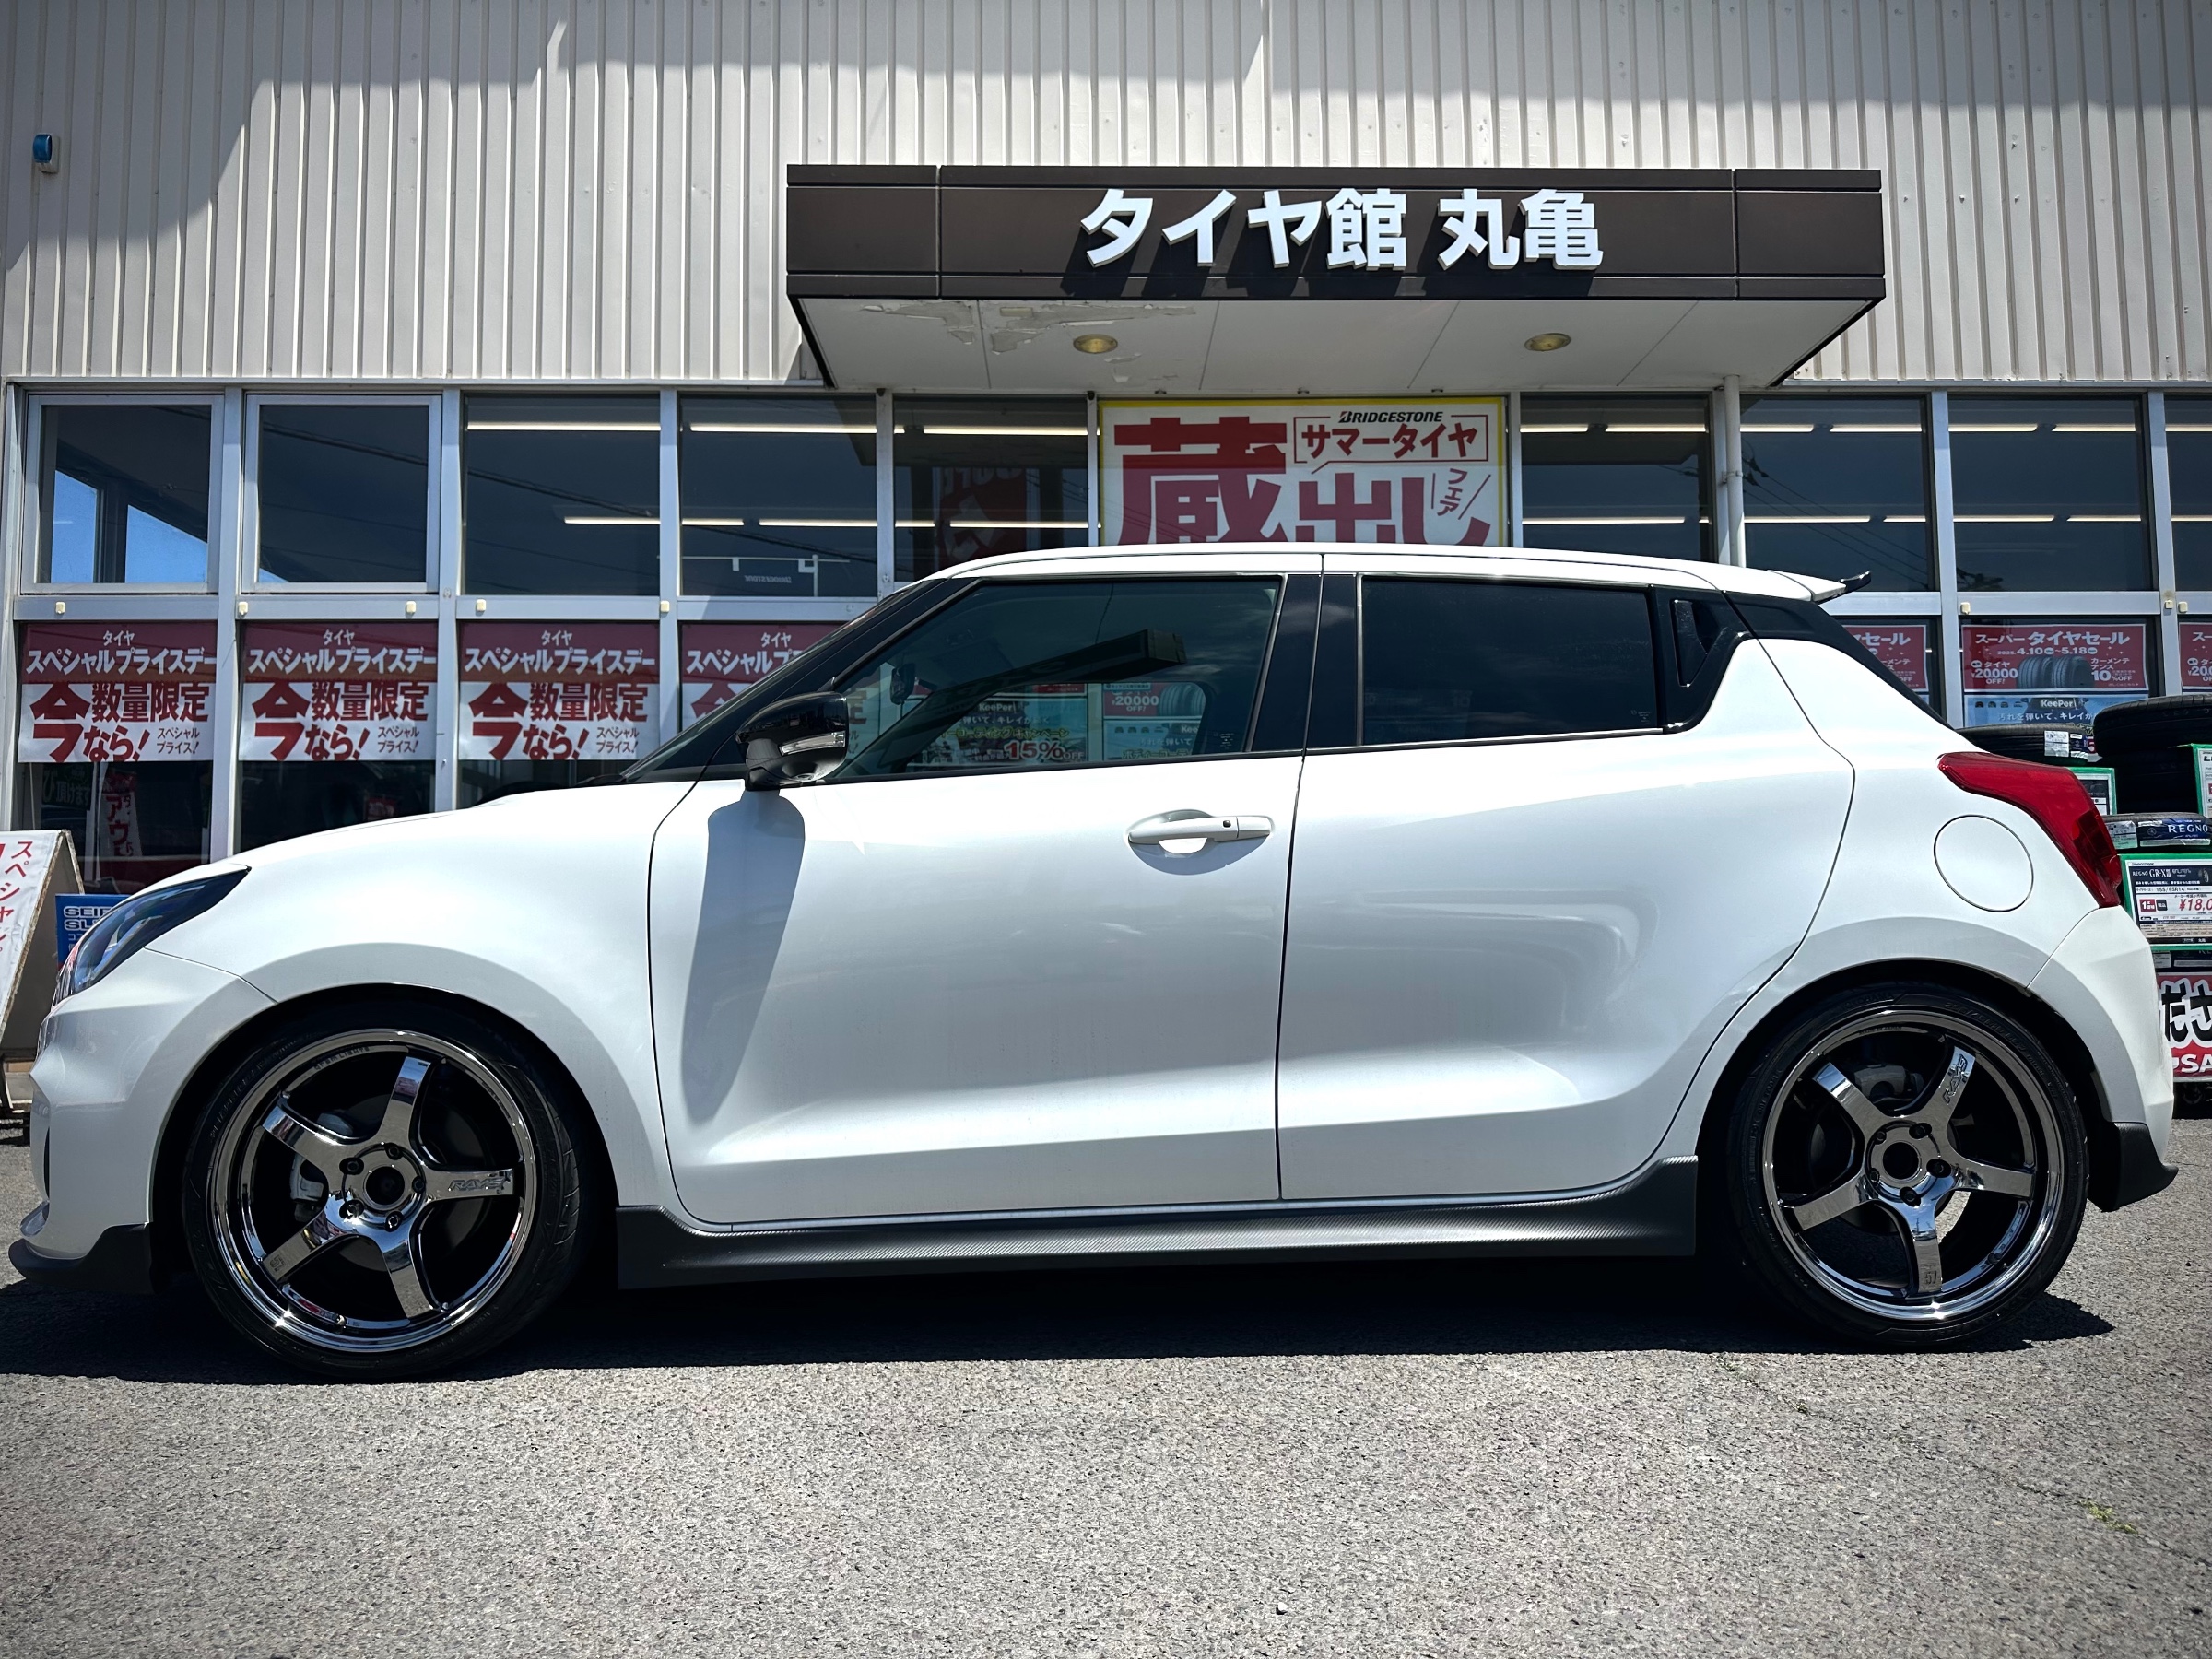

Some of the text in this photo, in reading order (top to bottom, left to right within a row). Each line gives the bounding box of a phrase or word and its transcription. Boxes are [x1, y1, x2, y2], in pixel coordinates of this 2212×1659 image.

[1081, 188, 1604, 271] タイヤ館 丸亀
[1338, 411, 1443, 423] BRIDGESTONE
[1301, 423, 1477, 459] サマータイヤ
[1114, 417, 1491, 547] 蔵出し
[1437, 468, 1468, 516] フェア
[103, 630, 135, 646] タイヤ
[323, 629, 355, 645] タイヤ
[541, 630, 572, 646] タイヤ
[760, 632, 793, 648] タイヤ
[26, 647, 217, 675] スペシャルプライスデー
[248, 647, 437, 675] スペシャルプライスデー
[465, 647, 655, 675] スペシャルプライスデー
[91, 682, 209, 723] 数量限定
[312, 682, 429, 722] 数量限定
[530, 682, 648, 722] 数量限定
[979, 703, 1013, 712] KeePer
[2041, 700, 2073, 708] KeePer
[157, 728, 200, 739] スペシャル
[378, 726, 419, 738] スペシャル
[597, 727, 640, 739] スペシャル
[2167, 824, 2209, 833] REGNO
[65, 919, 99, 931] SL
[447, 1177, 504, 1192] RAYS
